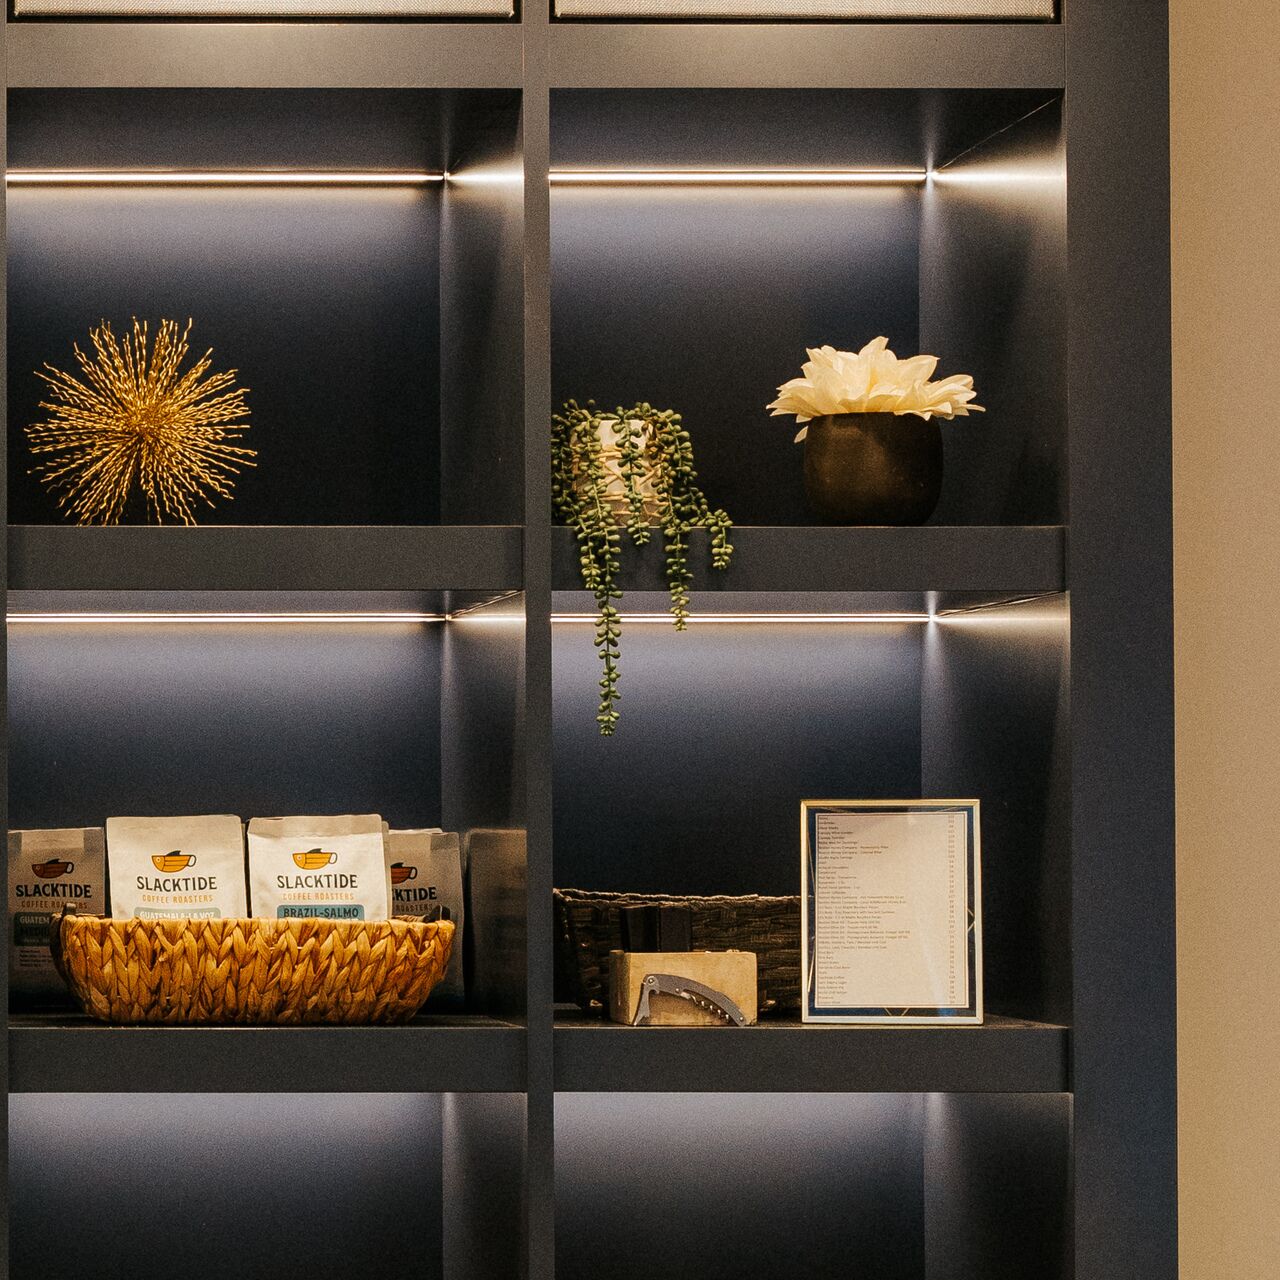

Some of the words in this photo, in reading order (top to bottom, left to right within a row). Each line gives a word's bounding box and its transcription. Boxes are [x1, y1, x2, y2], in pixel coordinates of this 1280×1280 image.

[137, 876, 217, 892] SLACKTIDE
[277, 874, 359, 889] SLACKTIDE
[15, 883, 93, 898] SLACKTIDE
[283, 892, 311, 901] COFFEE
[314, 892, 354, 901] ROASTERS
[392, 887, 437, 901] KTIDE
[21, 900, 47, 909] COFFEE
[142, 894, 169, 904] COFFEE
[172, 894, 214, 904] ROASTERS
[283, 908, 359, 918] BRAZIL-SALMO
